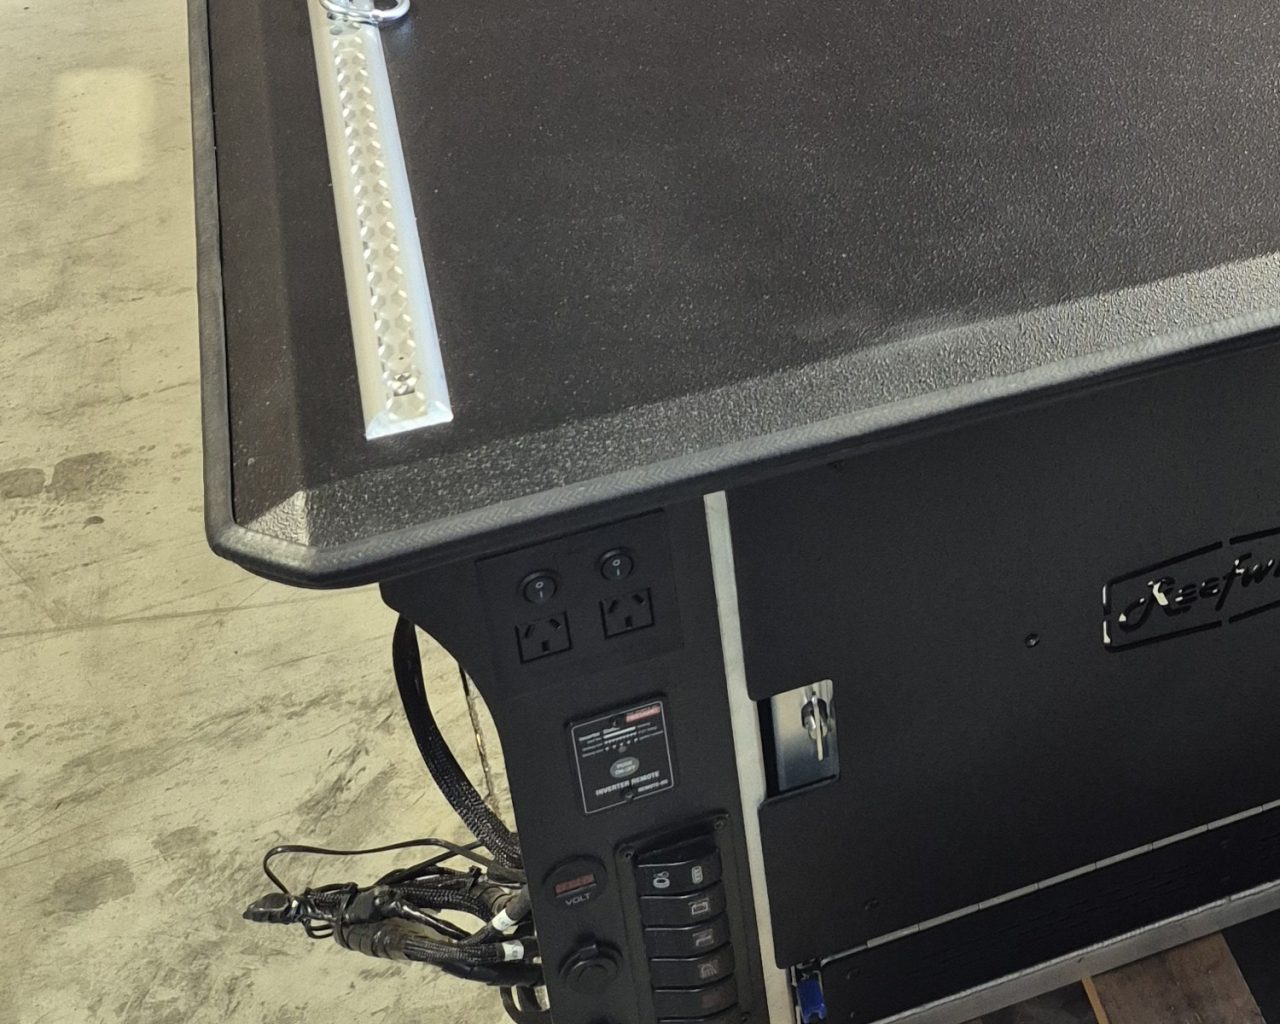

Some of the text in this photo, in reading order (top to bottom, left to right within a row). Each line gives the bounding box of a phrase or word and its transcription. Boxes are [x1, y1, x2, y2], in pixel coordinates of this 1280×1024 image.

[596, 770, 660, 796] INVERTER REMOTE
[565, 892, 592, 906] VOLT
